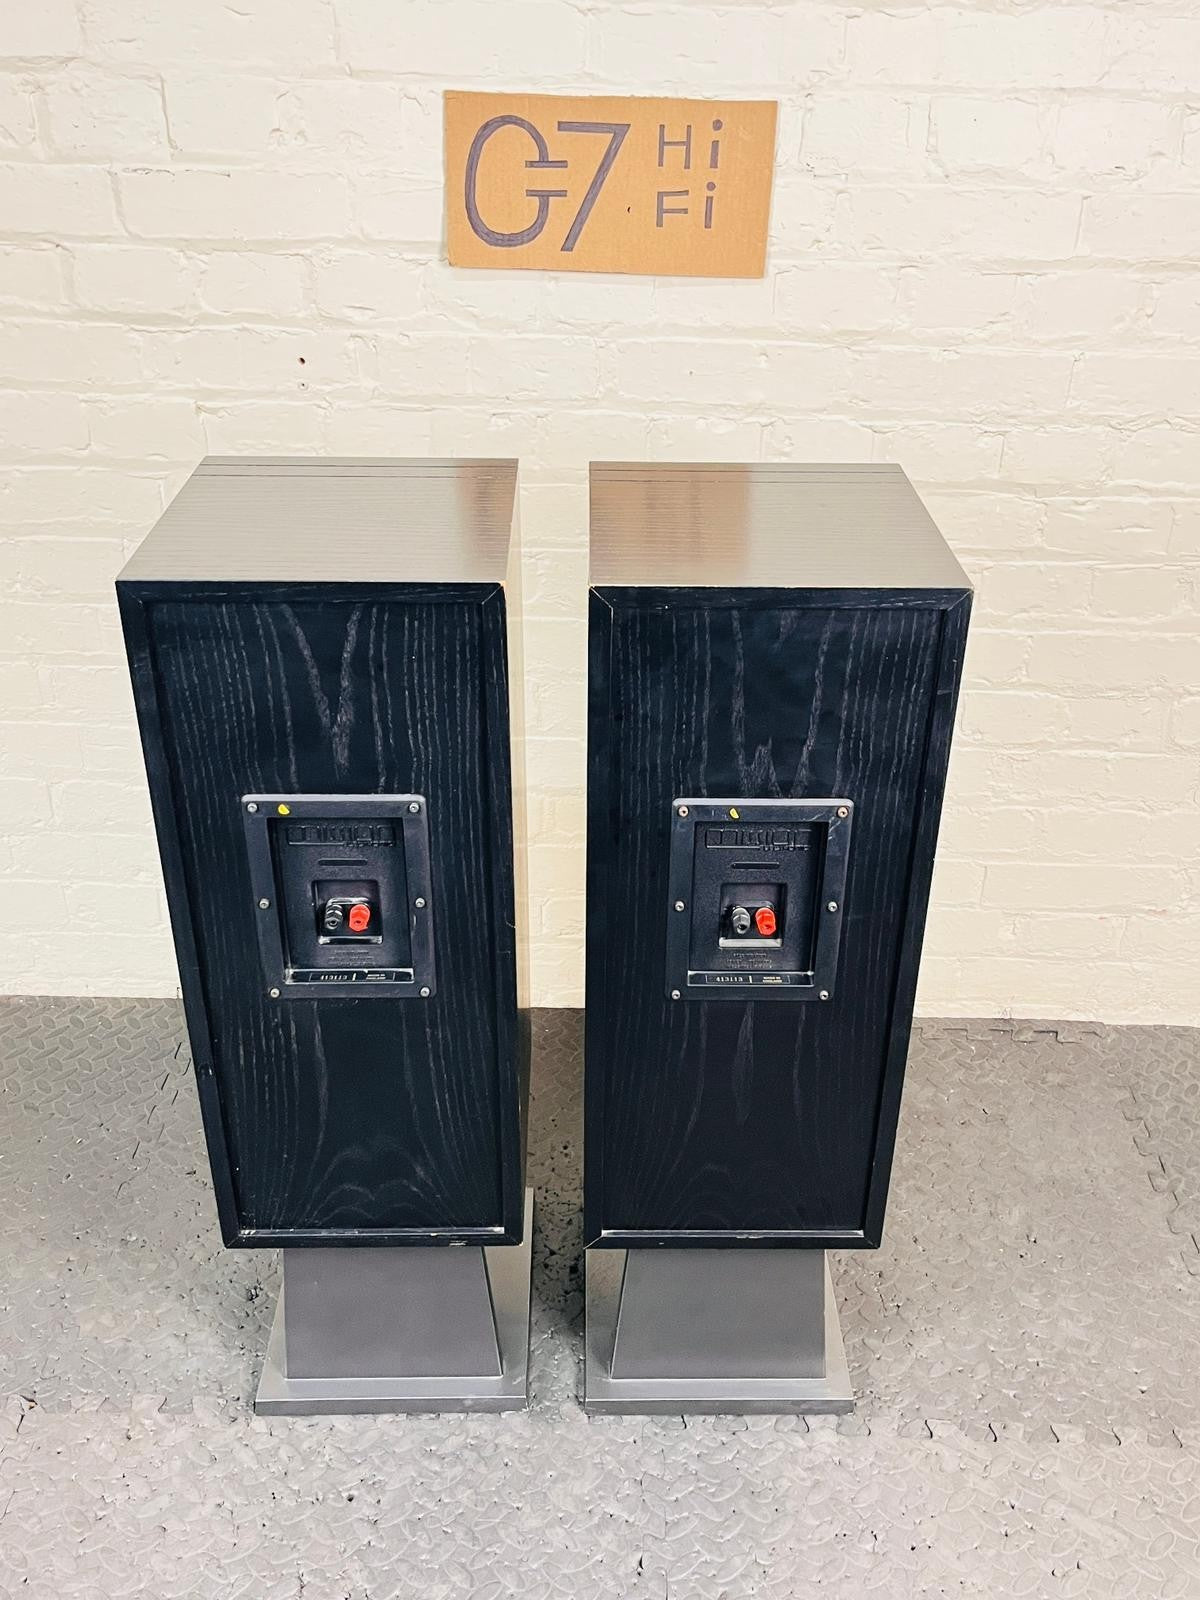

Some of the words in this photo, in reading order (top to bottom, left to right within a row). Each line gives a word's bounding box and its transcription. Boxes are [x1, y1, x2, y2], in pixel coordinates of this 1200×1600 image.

[657, 118, 724, 170] Hi
[464, 114, 632, 252] G7
[656, 181, 717, 229] Fi
